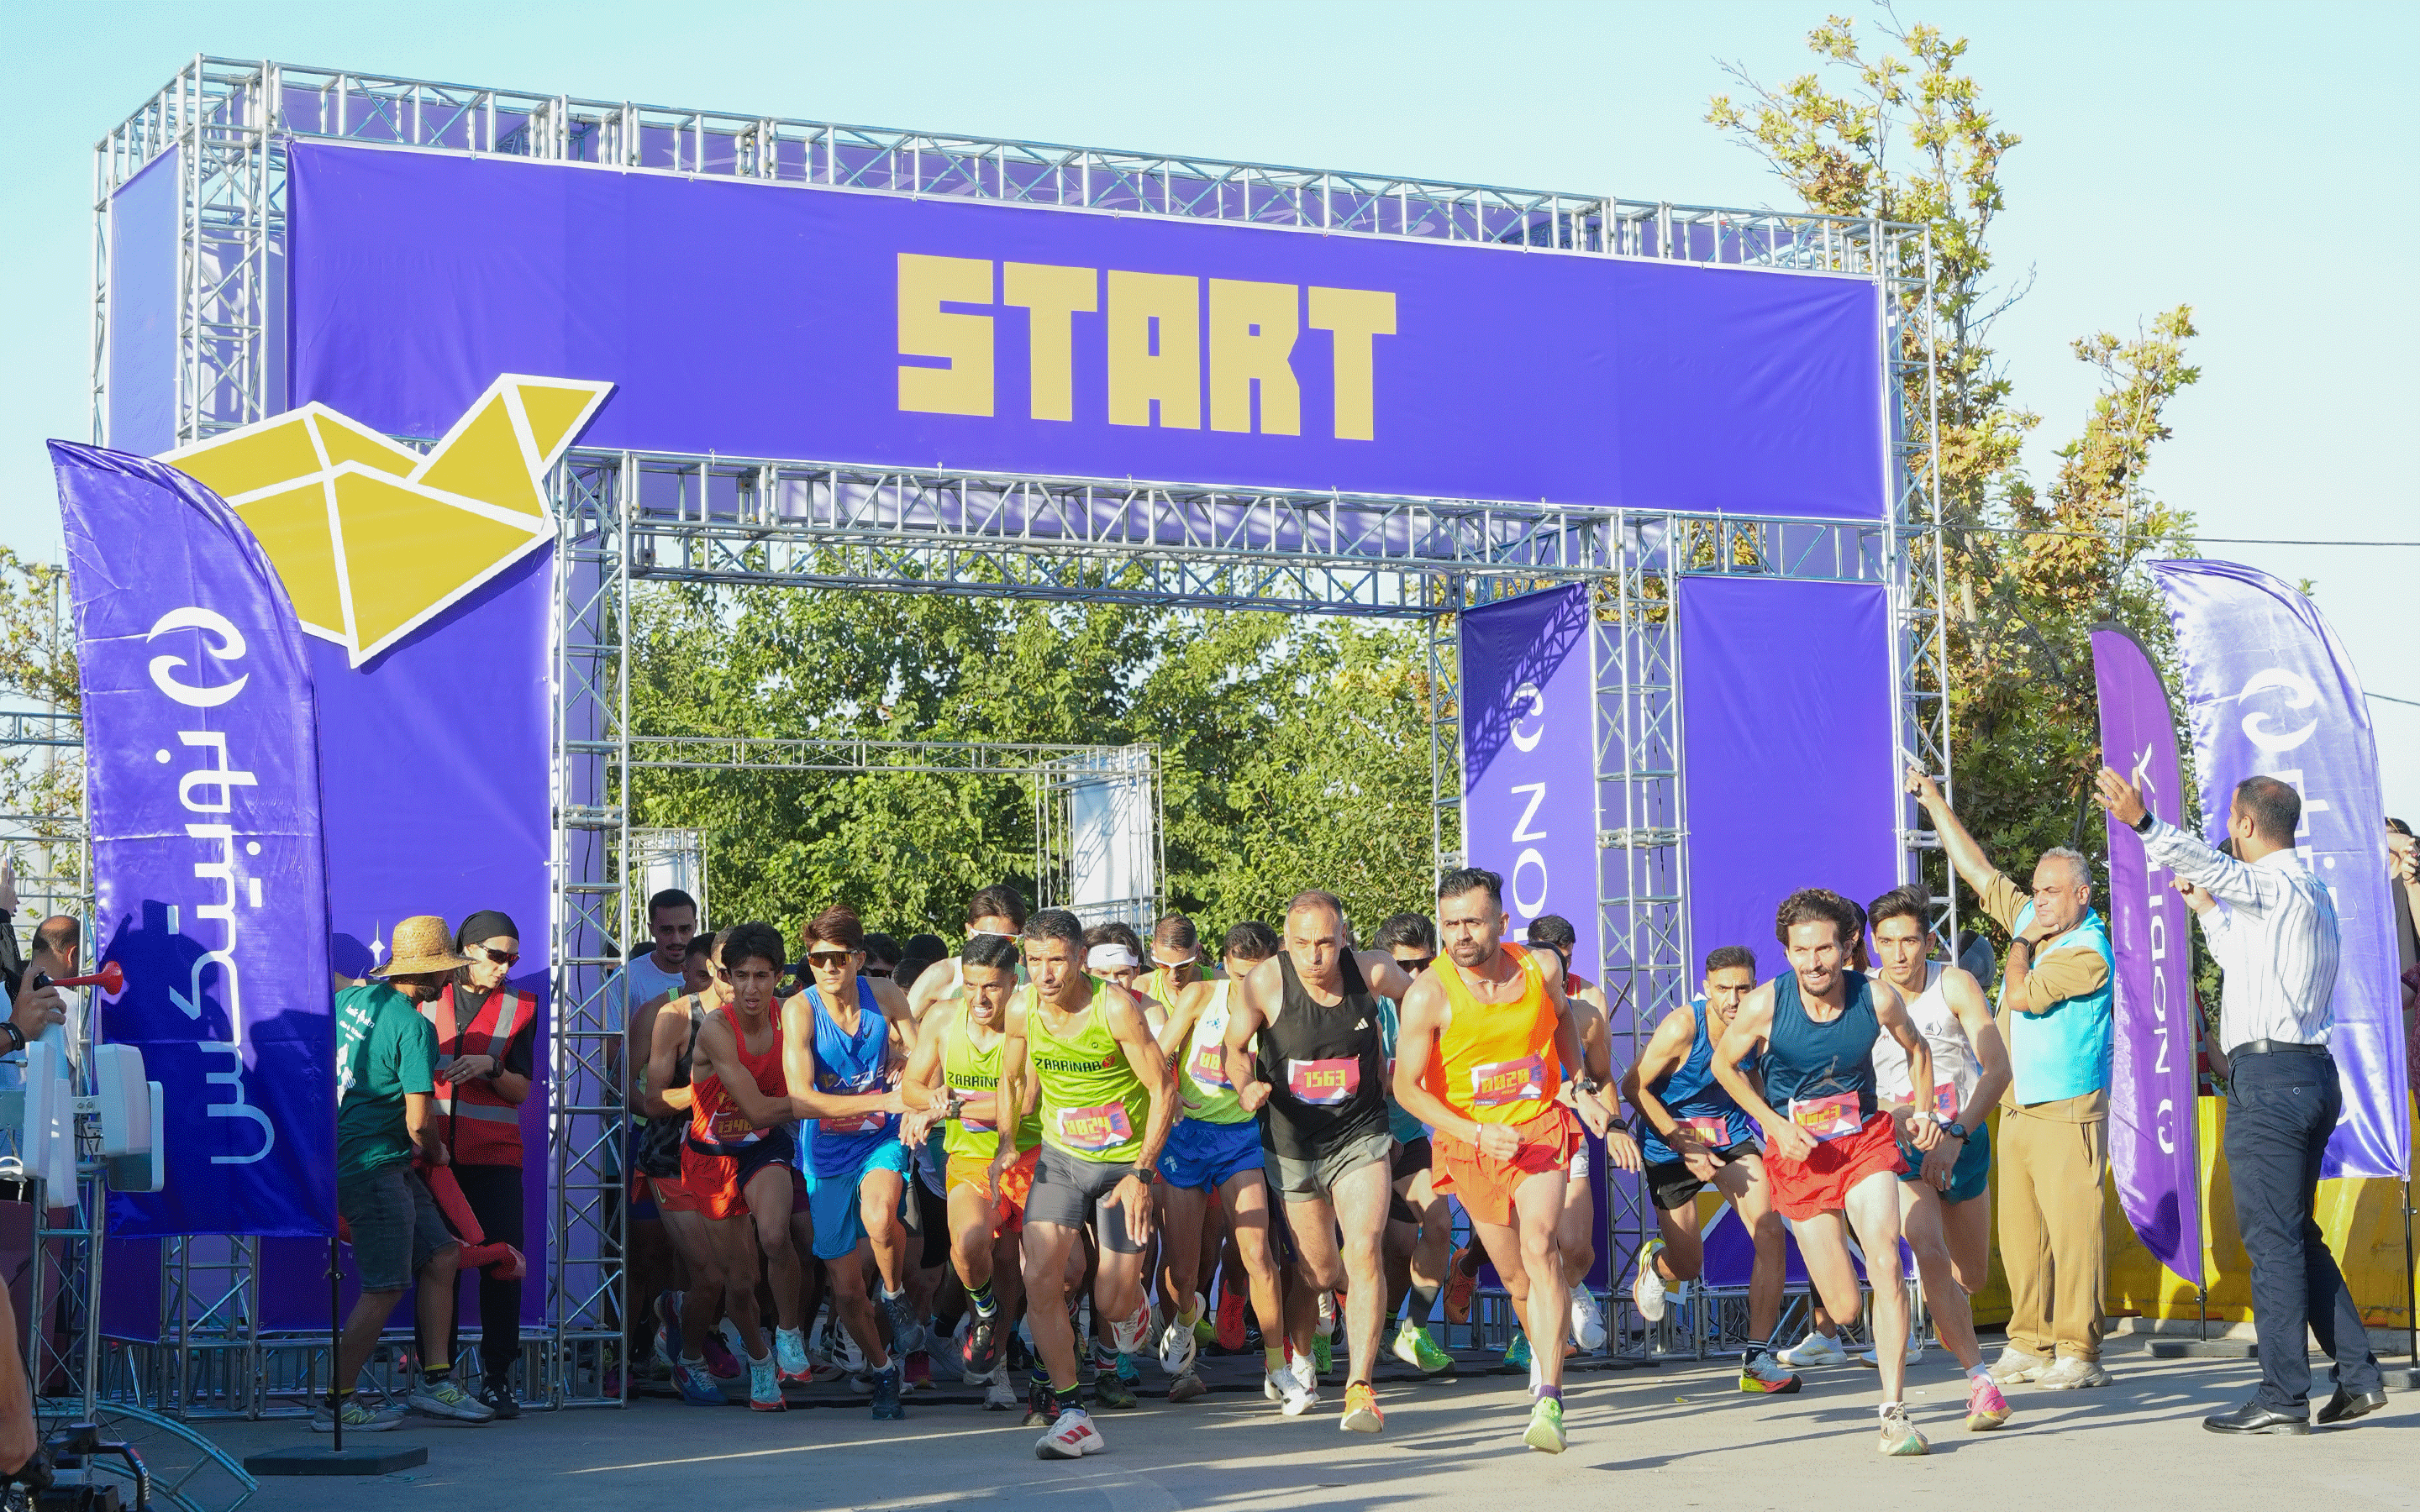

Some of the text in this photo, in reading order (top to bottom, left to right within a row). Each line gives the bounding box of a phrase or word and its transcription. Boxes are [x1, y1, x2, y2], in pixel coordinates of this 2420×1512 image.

[897, 252, 1397, 442] START
[1304, 1069, 1346, 1089] 1563
[135, 1459, 151, 1501] RONIN
